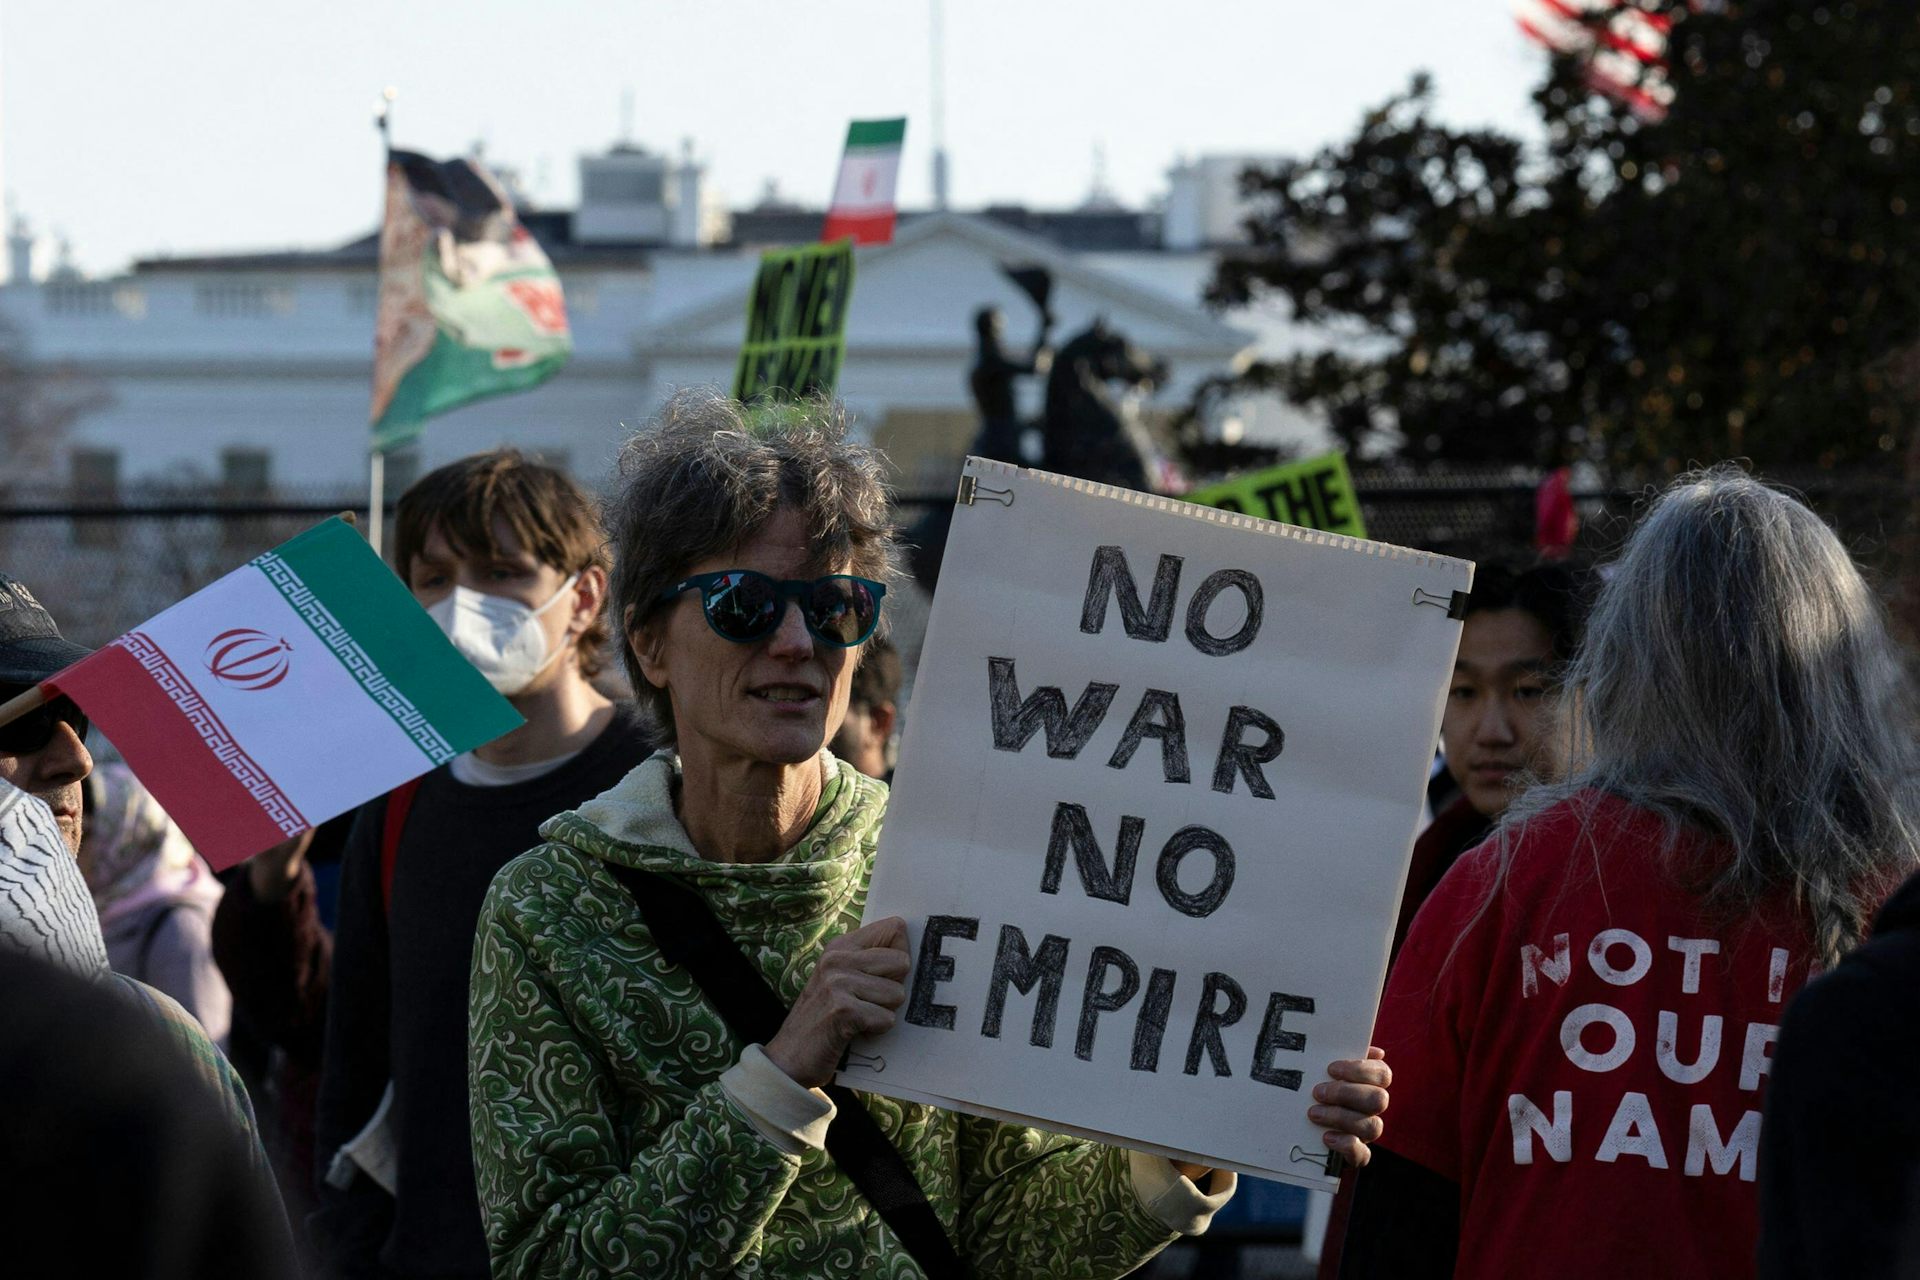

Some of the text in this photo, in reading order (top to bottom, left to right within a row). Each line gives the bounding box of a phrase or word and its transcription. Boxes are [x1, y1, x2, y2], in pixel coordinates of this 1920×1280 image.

[1255, 467, 1350, 529] THE
[1080, 545, 1264, 657] NO
[987, 656, 1286, 800] WAR
[1040, 802, 1236, 918] NO
[904, 914, 1316, 1091] EMPIRE
[1520, 928, 1721, 998] NOT
[1508, 1090, 1763, 1182] NAM
